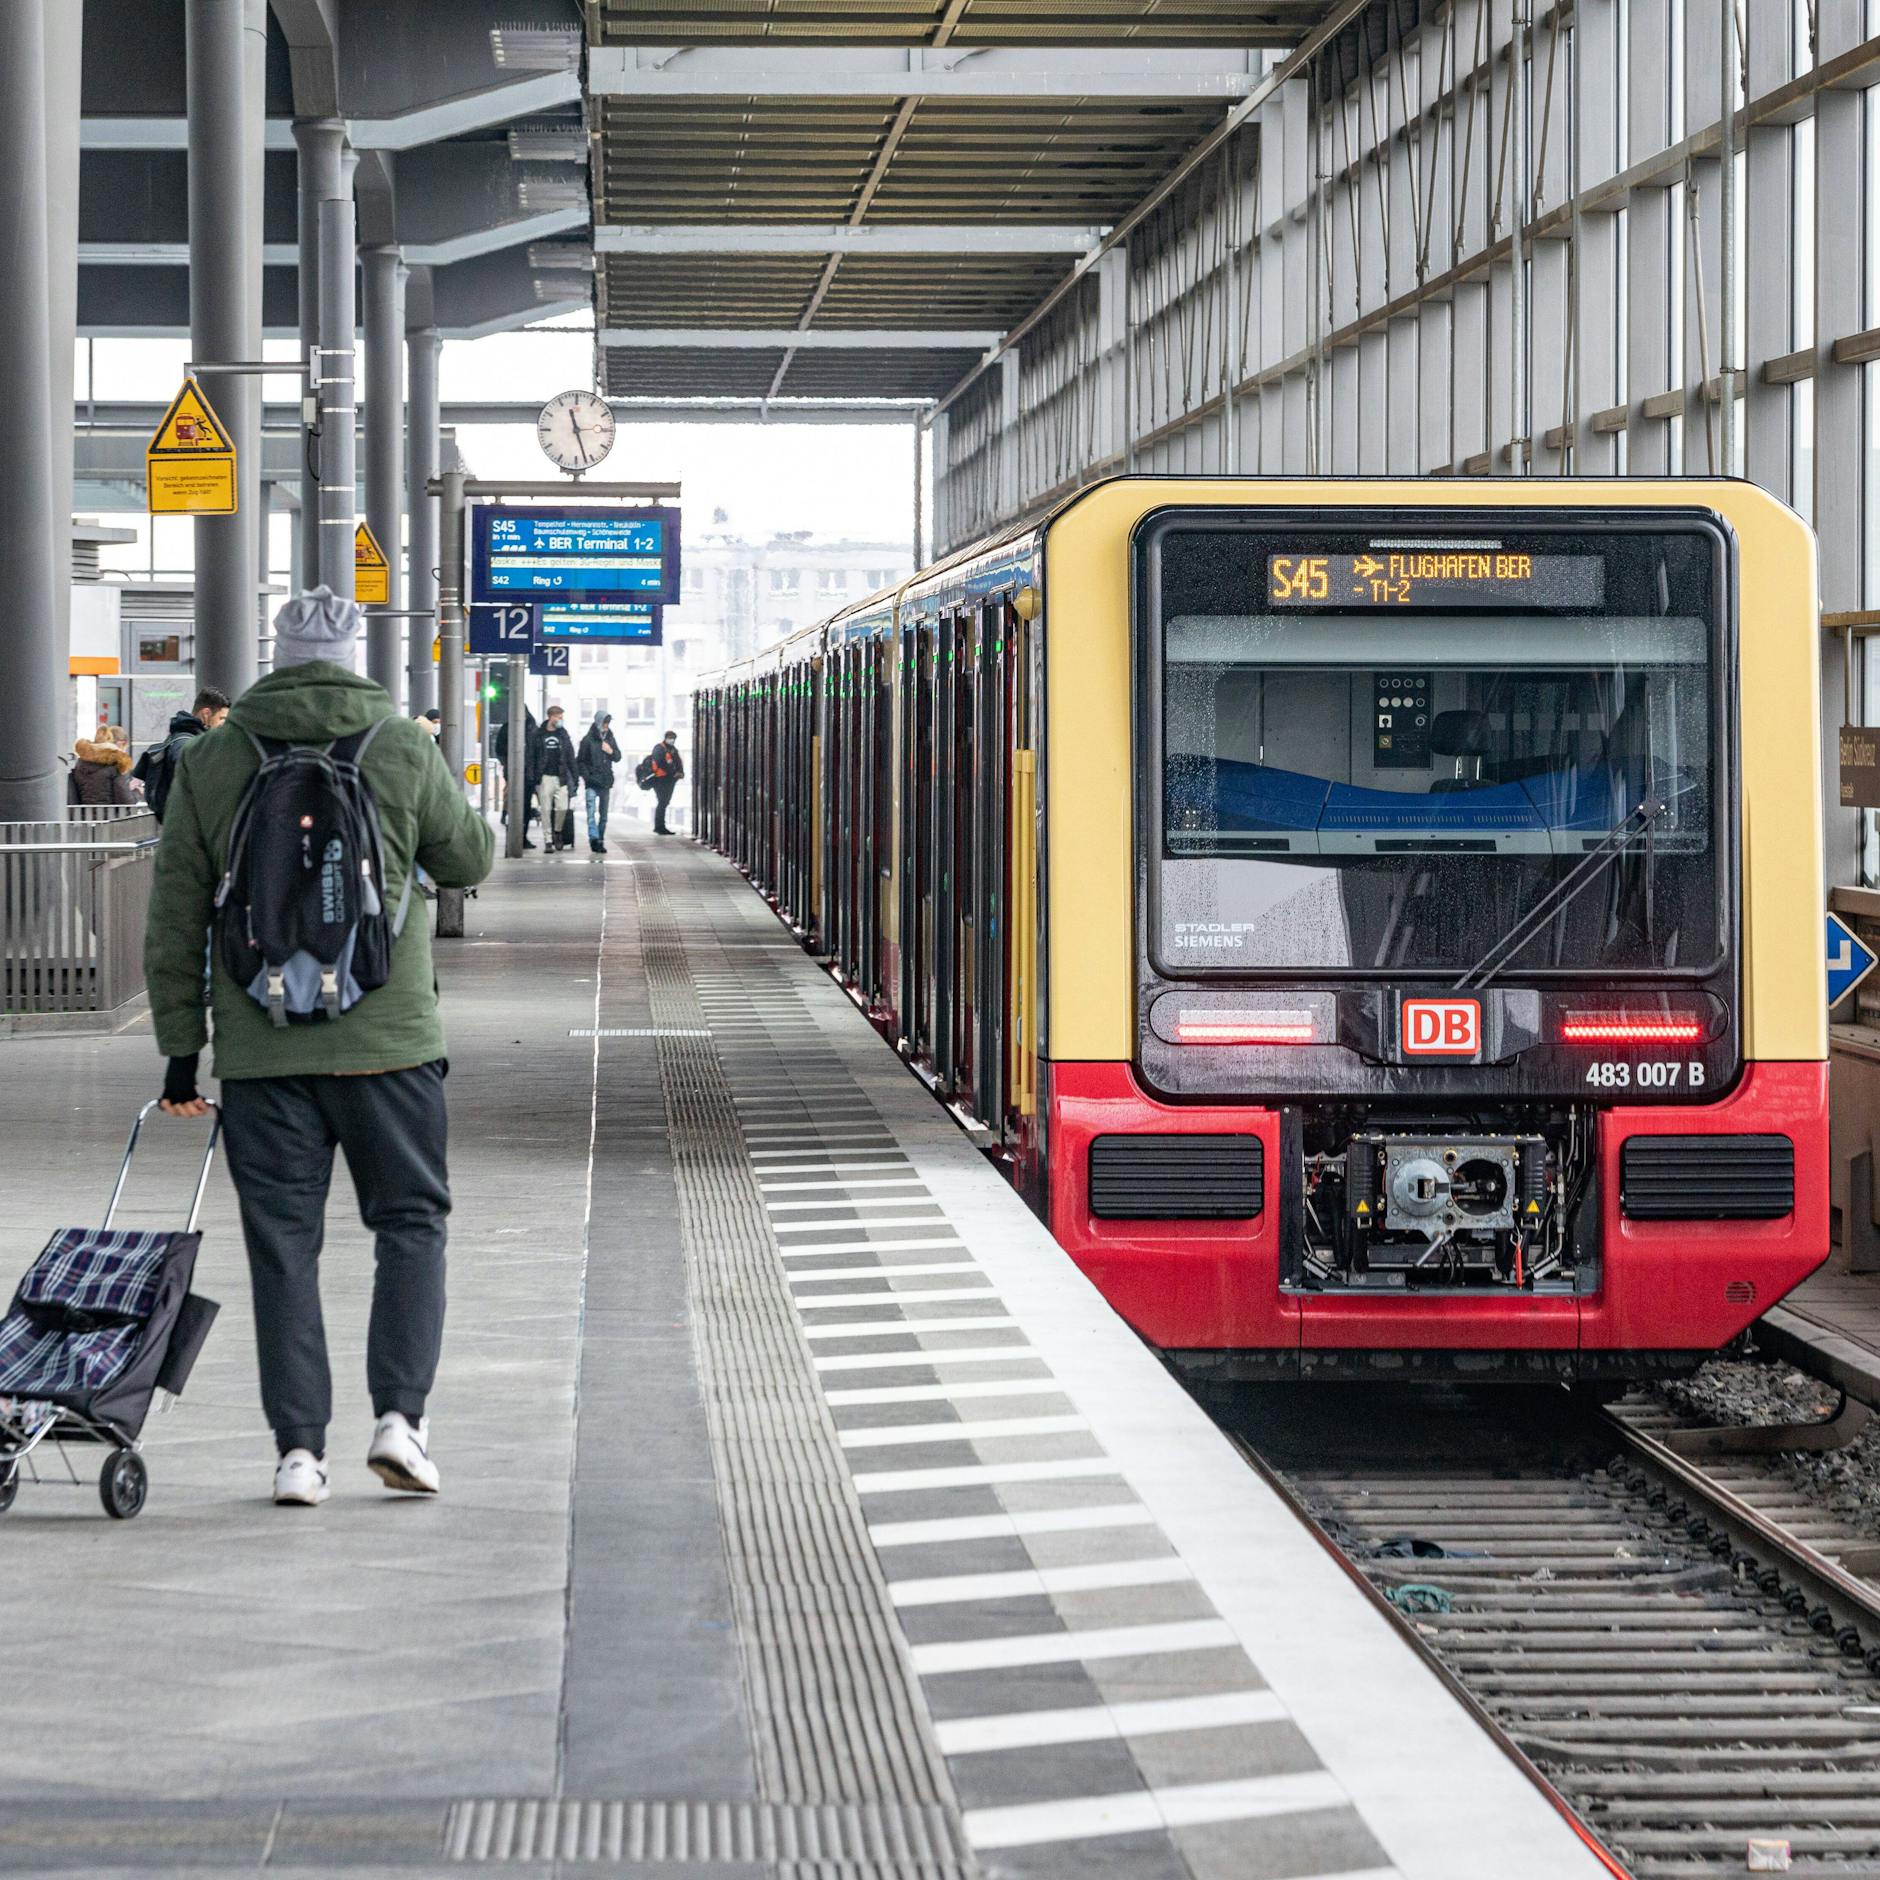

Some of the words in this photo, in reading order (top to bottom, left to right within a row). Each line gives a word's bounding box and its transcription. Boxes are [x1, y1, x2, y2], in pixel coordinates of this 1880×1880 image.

[492, 520, 516, 532] S45
[549, 537, 572, 549] BER
[576, 537, 628, 550] Terminal
[634, 537, 654, 550] 1-2
[1390, 555, 1490, 578] FLUGHAFEN
[1496, 555, 1531, 578] BER
[492, 576, 510, 585] S42
[533, 576, 550, 587] Ring
[1273, 559, 1328, 598] S45
[1371, 580, 1410, 602] T1-2
[493, 608, 528, 639] 12
[543, 647, 567, 667] 12
[1174, 923, 1255, 932] STADLER
[1174, 935, 1243, 947] SIEMENS
[1413, 1009, 1471, 1044] DB
[1586, 1062, 1630, 1087] 483
[1637, 1062, 1680, 1087] 007
[1688, 1062, 1705, 1087] B
